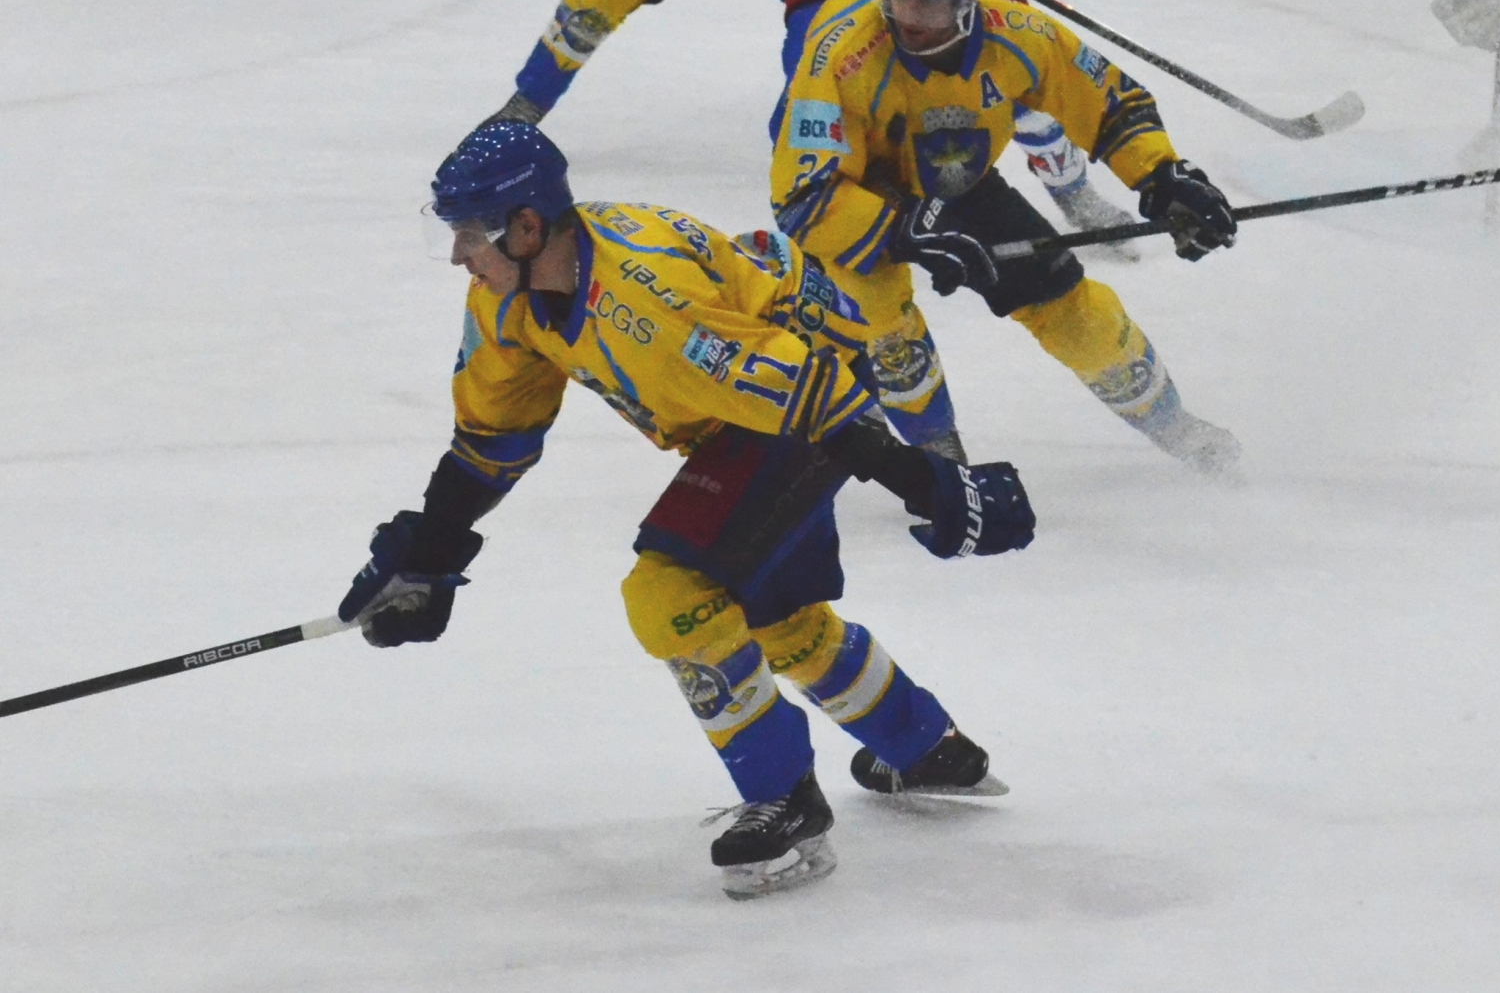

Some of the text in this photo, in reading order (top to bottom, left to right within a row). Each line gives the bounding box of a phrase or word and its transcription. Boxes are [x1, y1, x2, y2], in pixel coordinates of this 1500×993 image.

[979, 70, 1005, 110] A
[798, 118, 828, 140] BCR
[596, 291, 657, 345] CGS
[733, 351, 801, 409] 17
[183, 638, 263, 669] RIBCOR
